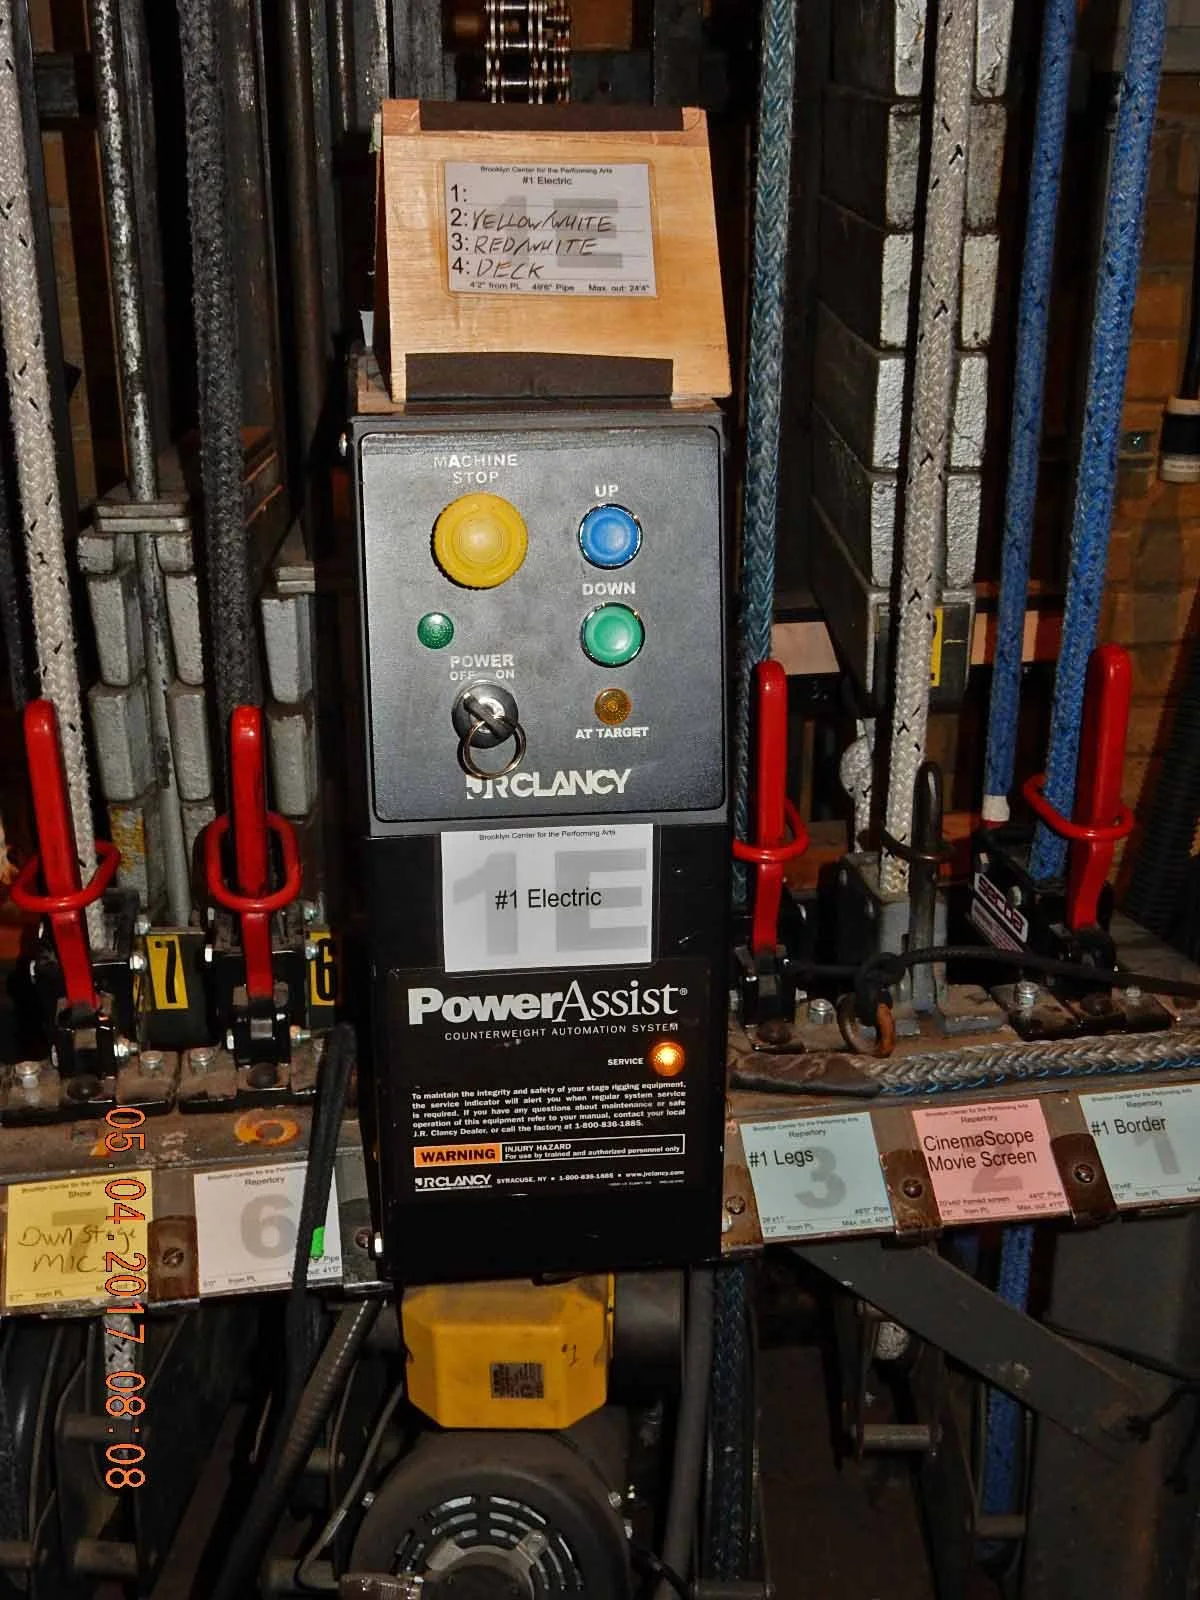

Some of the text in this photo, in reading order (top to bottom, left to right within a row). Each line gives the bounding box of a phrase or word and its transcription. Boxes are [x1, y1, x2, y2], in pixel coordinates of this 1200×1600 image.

[480, 166, 510, 174] Brooklyn
[560, 167, 598, 175] Performing
[522, 176, 573, 185] #1 Electric
[450, 183, 467, 202] 1:
[450, 208, 468, 227] 2:
[451, 233, 469, 252] 3:
[452, 257, 545, 280] 4: DECK
[555, 284, 575, 293] Pipe
[433, 454, 519, 469] MACHINE
[452, 471, 499, 485] STOP
[594, 484, 619, 498] UP
[581, 581, 636, 596] DOWN
[449, 654, 515, 668] POWER
[449, 669, 515, 681] OFF ON
[575, 725, 649, 739] AT TARGET
[479, 832, 510, 841] Brooklyn
[512, 831, 535, 840] Center
[548, 830, 560, 838] the
[561, 829, 600, 838] Performing
[601, 828, 616, 836] Arts
[495, 887, 602, 910] #1 Electric
[154, 940, 177, 1003] 7
[315, 938, 337, 1001] 6
[444, 1022, 679, 1041] COUNTERWEIGHT AUTOMATION SYSTEM
[607, 1057, 645, 1066] SERVICE
[412, 1092, 422, 1100] To
[423, 1091, 459, 1100] maintain
[477, 1088, 511, 1097] integrity
[513, 1087, 528, 1095] and
[530, 1086, 555, 1095] safety
[567, 1085, 584, 1094] your
[586, 1084, 609, 1093] stage
[611, 1082, 640, 1091] rigging
[412, 1090, 686, 1110] the service indicator will alert you when regular system service
[412, 1111, 420, 1119] is
[423, 1110, 459, 1118] required.
[473, 1109, 487, 1117] you
[491, 1107, 510, 1115] have
[514, 1107, 528, 1115] any
[532, 1105, 571, 1114] questions
[575, 1103, 598, 1111] about
[601, 1102, 653, 1110] maintenance
[668, 1099, 686, 1107] safe
[412, 1119, 451, 1128] operation
[482, 1116, 525, 1125] equipment
[560, 1113, 577, 1121] your
[613, 1110, 644, 1118] contact
[646, 1109, 664, 1118] your
[666, 1108, 686, 1116] local
[430, 1129, 458, 1137] Clancy
[533, 1124, 562, 1132] factory
[564, 1122, 572, 1130] at
[1091, 1115, 1168, 1136] #1 Border
[504, 1143, 572, 1153] INJURY HAZARD
[923, 1129, 1035, 1152] CinemaScope
[421, 1149, 496, 1163] WARNING
[544, 1150, 571, 1158] trained
[627, 1146, 663, 1154] personnel
[665, 1145, 680, 1153] only
[749, 1149, 814, 1167] #1 Legs
[927, 1151, 1038, 1172] Movie Screen
[240, 1193, 297, 1259] 6
